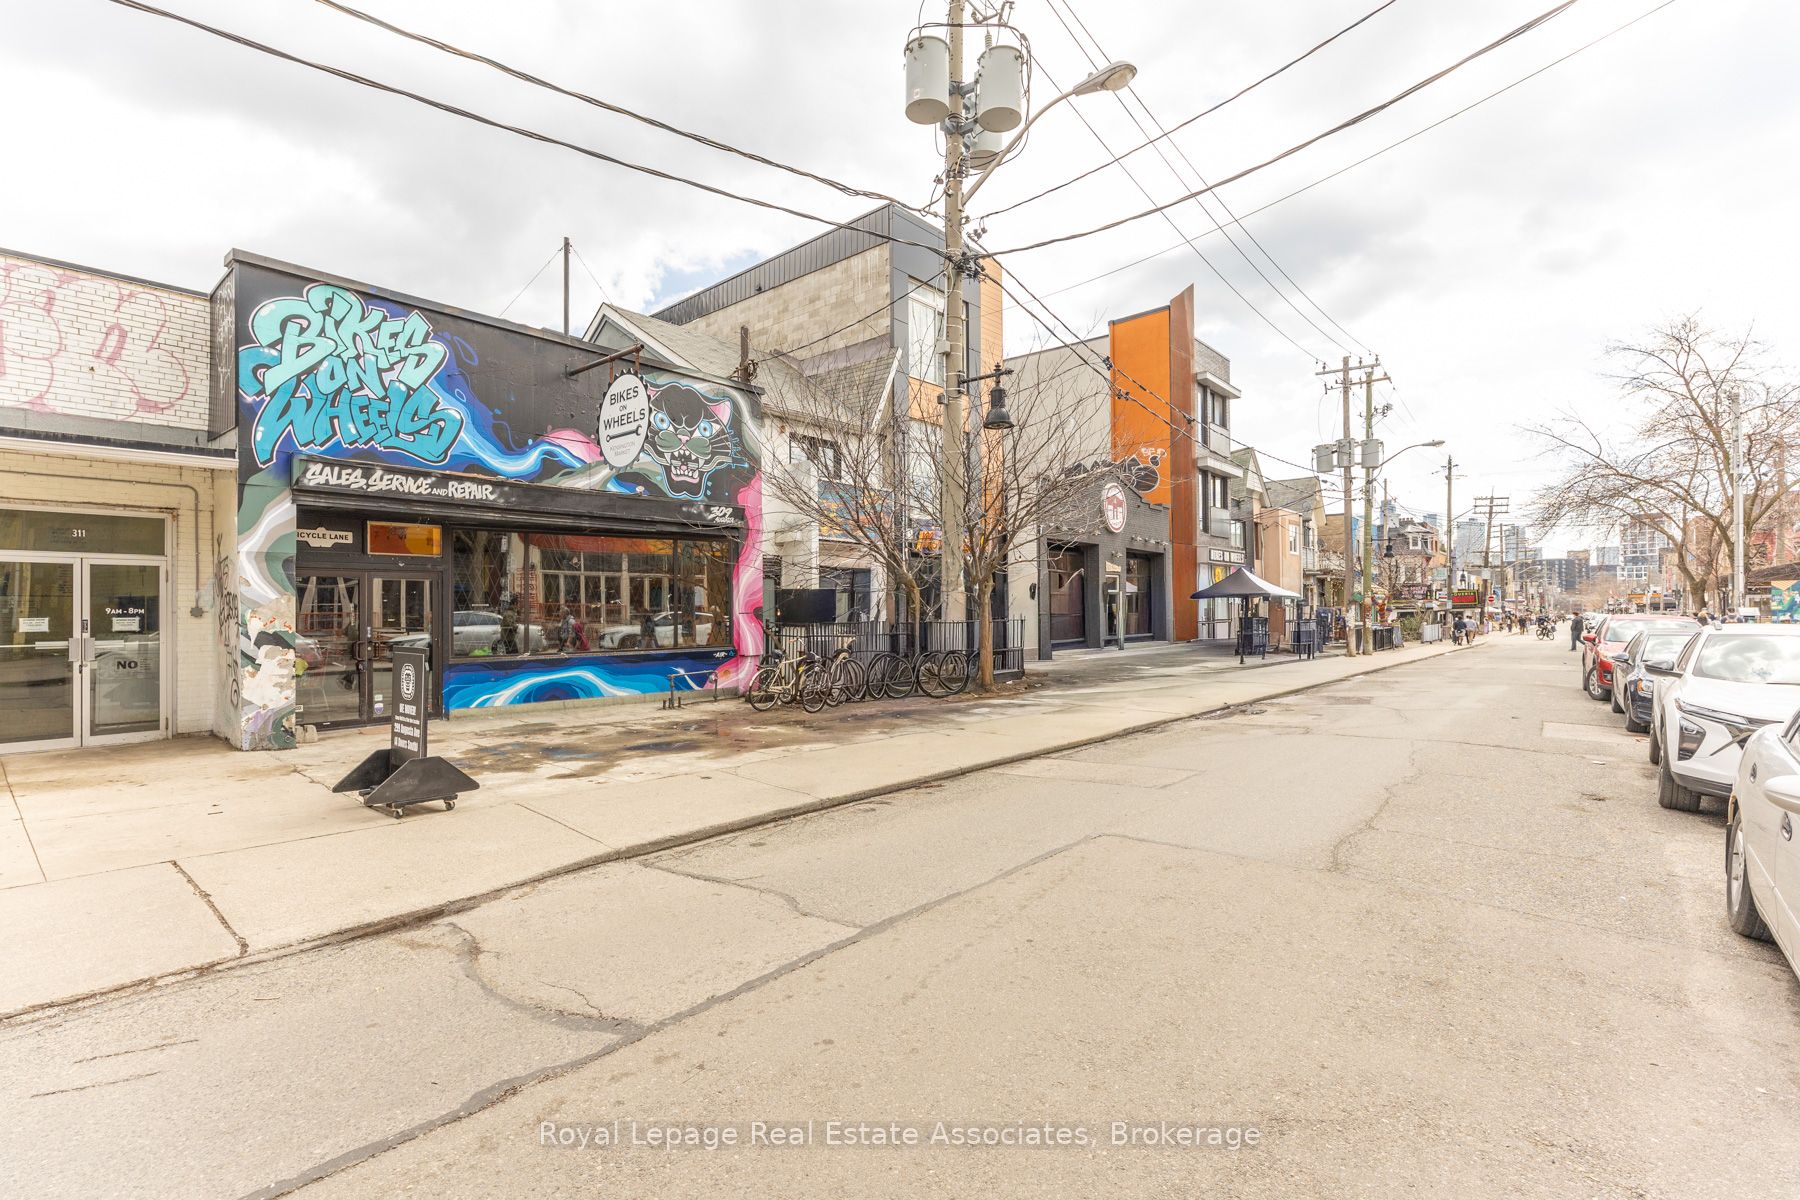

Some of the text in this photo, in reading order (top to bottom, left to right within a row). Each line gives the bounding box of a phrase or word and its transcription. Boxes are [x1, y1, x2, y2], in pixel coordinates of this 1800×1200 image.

[249, 283, 447, 396] BIKES
[315, 354, 387, 398] ON
[610, 386, 639, 405] BIKES
[239, 346, 465, 467] WHEELS
[619, 404, 627, 412] ON
[603, 408, 646, 431] WHEELS
[367, 468, 432, 495] SERVICE
[431, 487, 448, 497] AND
[448, 481, 498, 500] REPAIR
[708, 506, 734, 519] 309
[71, 528, 86, 538] 311
[297, 532, 327, 540] ICYCLE
[105, 607, 123, 615] 9AM
[116, 660, 138, 670] NO
